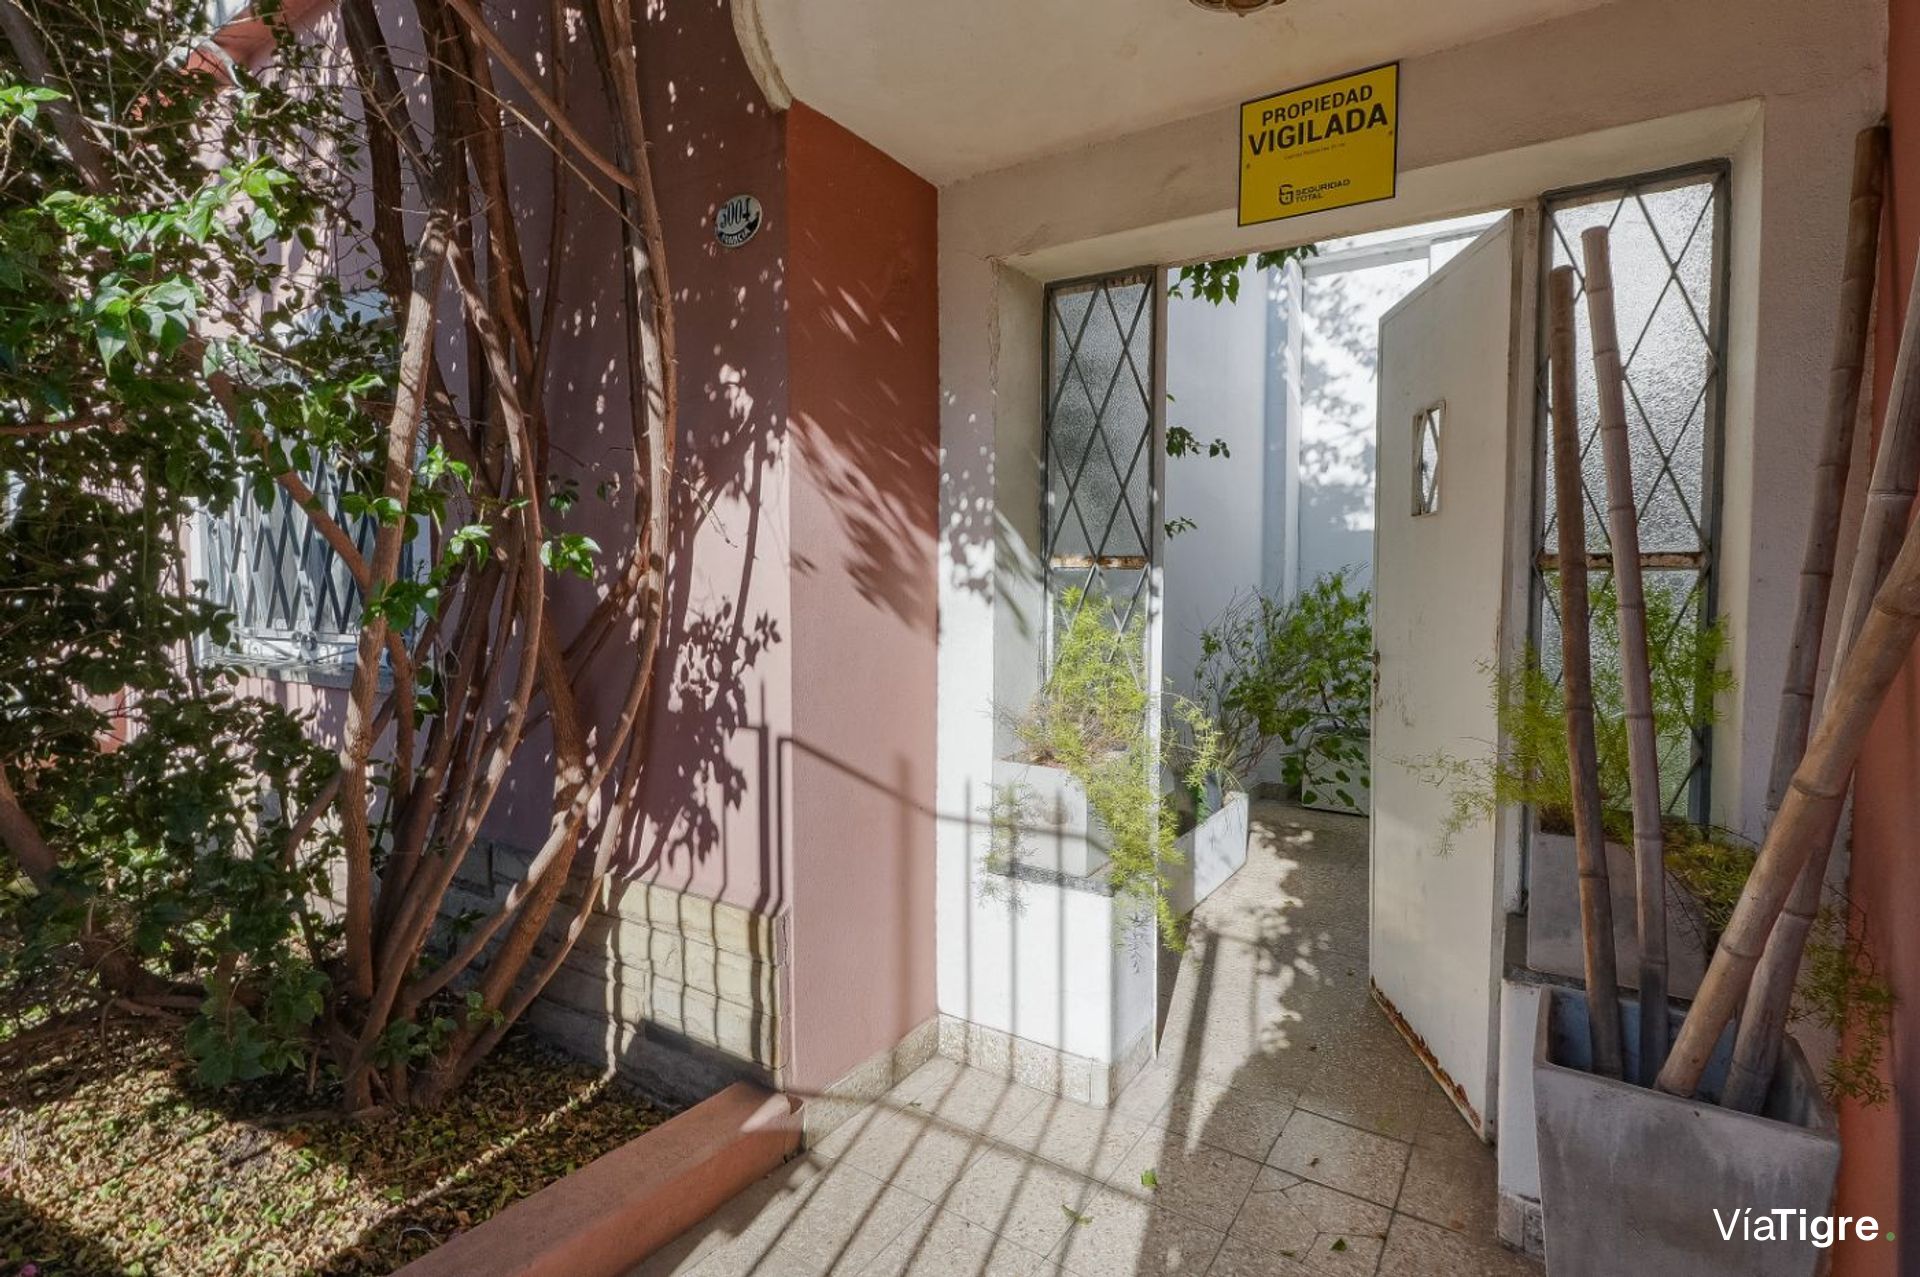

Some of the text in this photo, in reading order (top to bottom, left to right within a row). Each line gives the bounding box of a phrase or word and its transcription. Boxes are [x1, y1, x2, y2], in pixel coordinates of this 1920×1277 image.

[1262, 85, 1373, 126] PROPIEDAD
[1248, 102, 1388, 156] VIGILADA
[1295, 178, 1351, 196] SEGURIDAD
[1295, 192, 1324, 203] TOTAL
